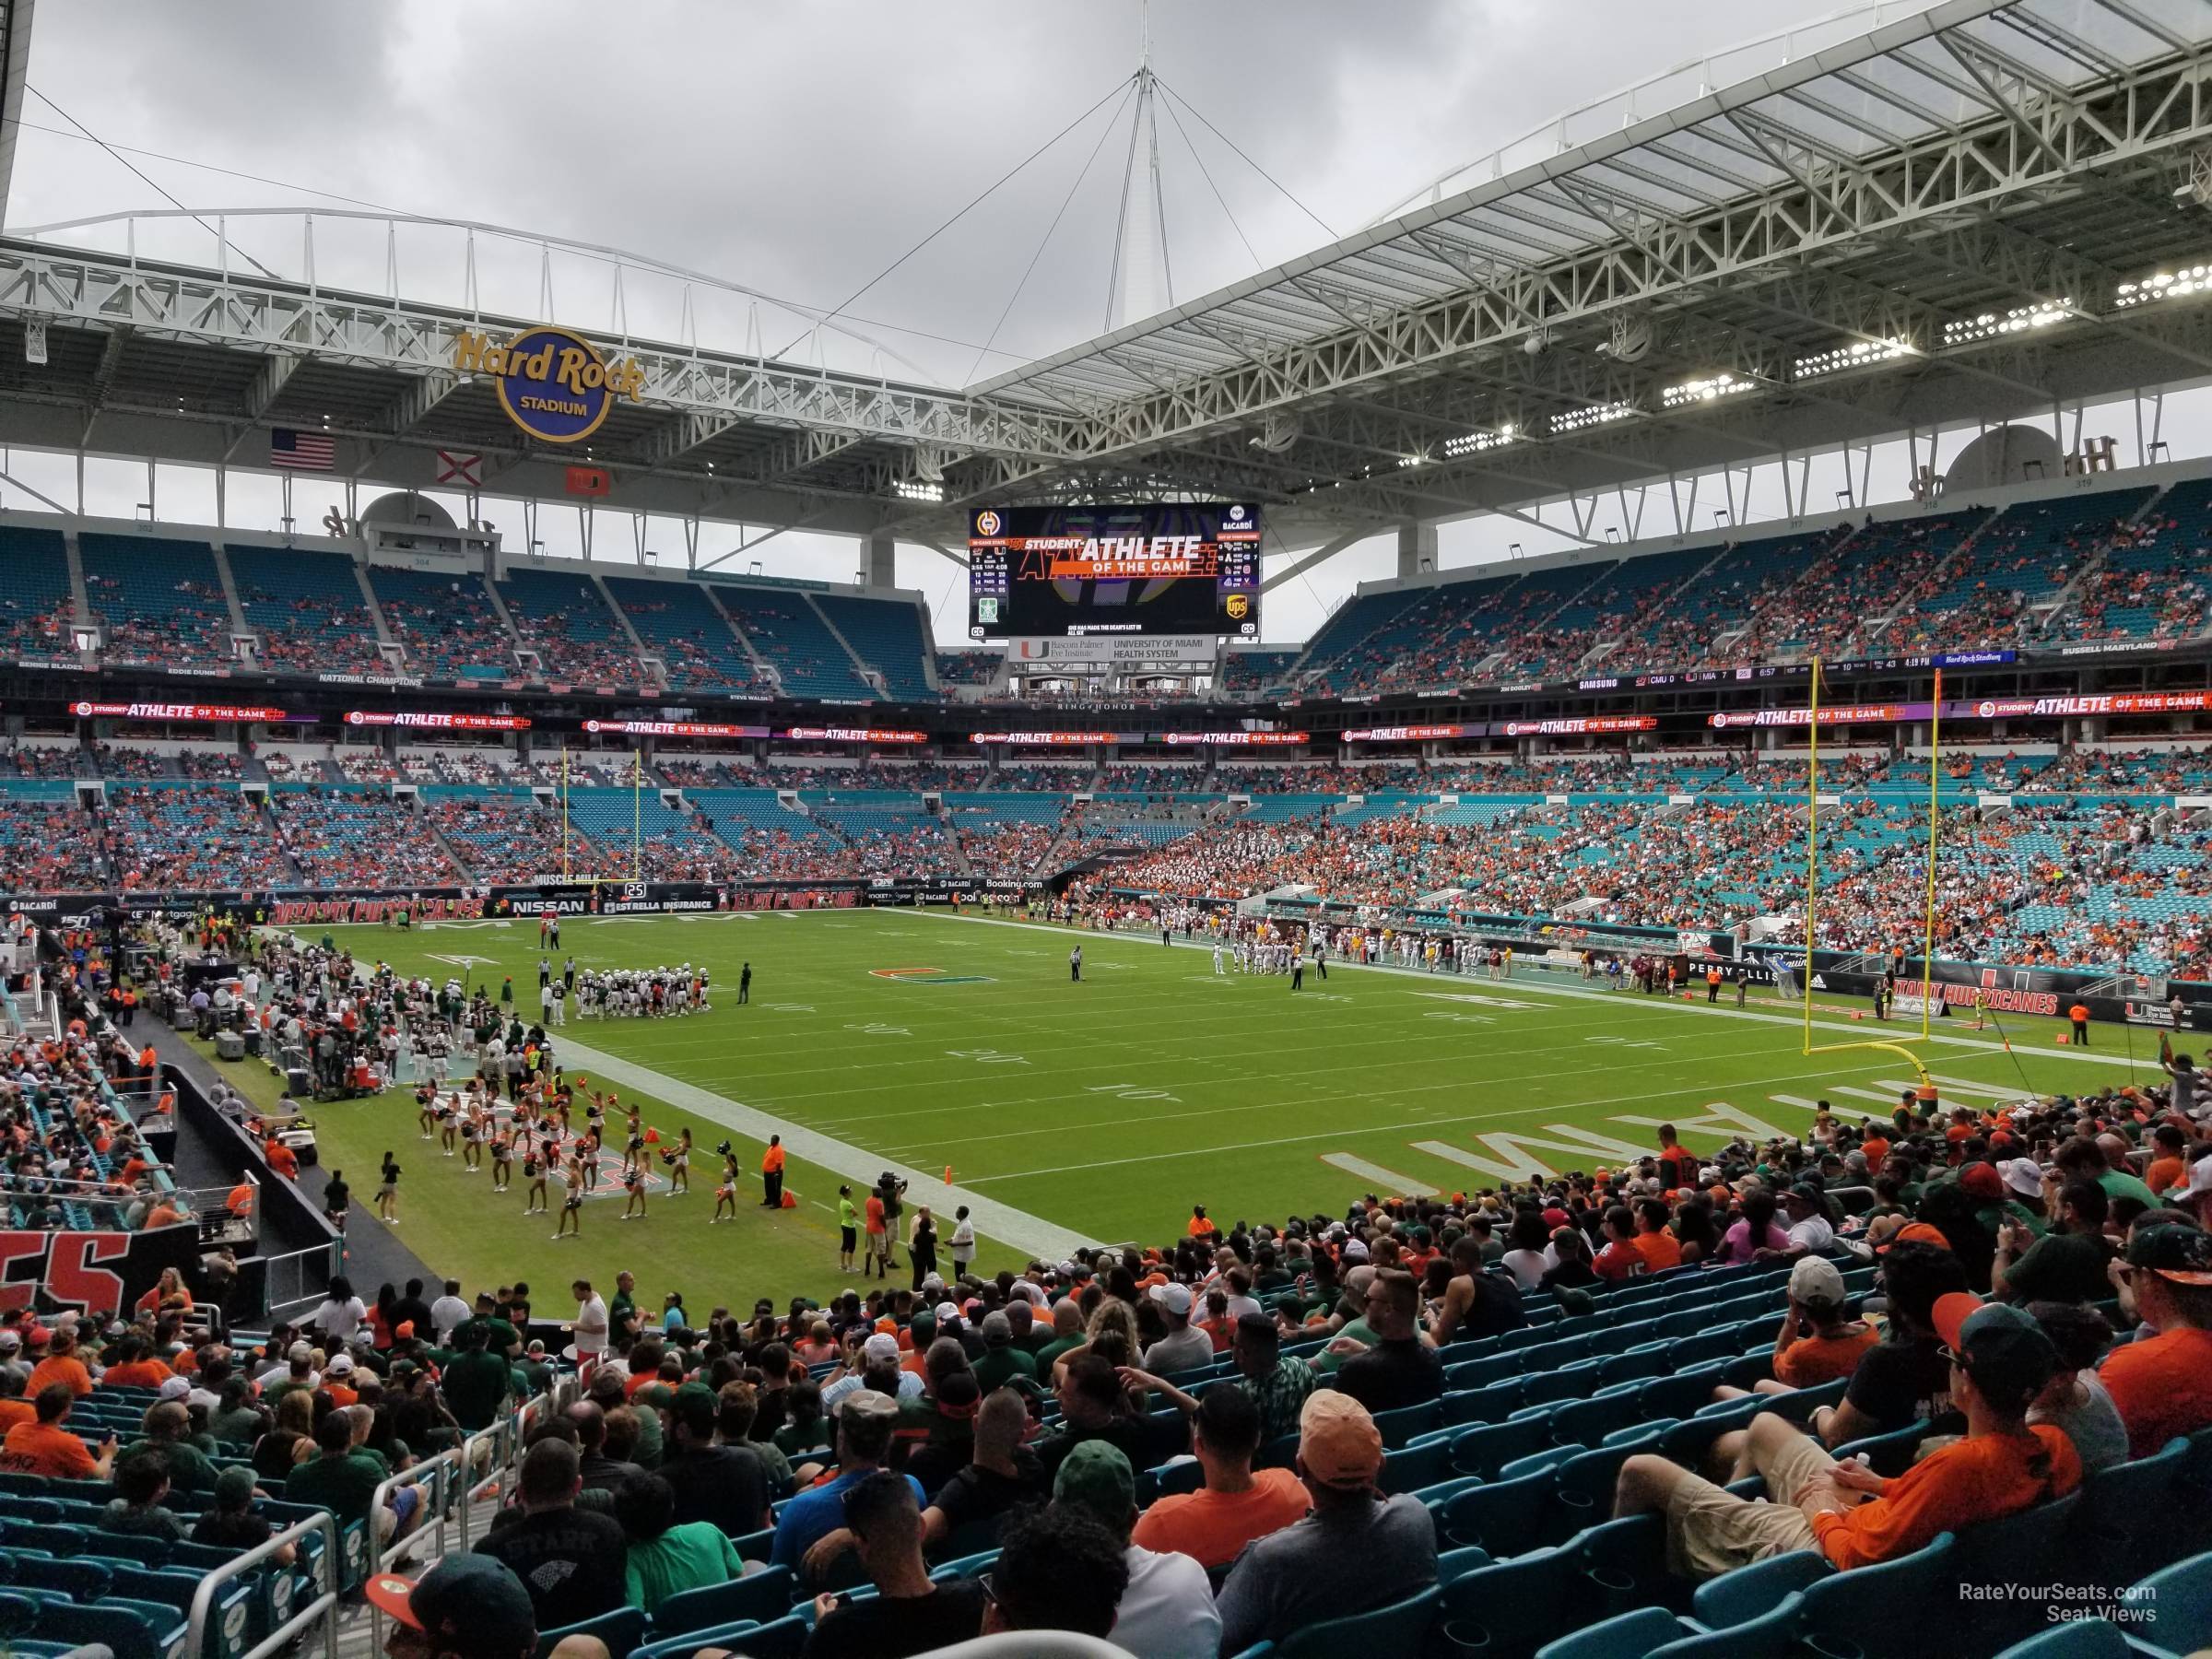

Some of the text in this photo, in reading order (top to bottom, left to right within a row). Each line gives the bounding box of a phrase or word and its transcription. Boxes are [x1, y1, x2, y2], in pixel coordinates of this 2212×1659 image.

[454, 331, 645, 403] Hard Rock
[521, 396, 587, 416] STADIUM
[1223, 520, 1253, 530] BACARDÍ
[1092, 562, 1112, 572] OF
[1119, 561, 1145, 572] THE
[1229, 601, 1246, 616] ups
[1113, 639, 1203, 649] UNIVERSITY OF MIAMI
[2063, 641, 2158, 655] RUSSELL MARYLAND
[1065, 649, 1093, 657] Institute
[1113, 650, 1179, 659] HEALTH SYSTEM
[1975, 653, 2002, 662] Stadium
[1886, 660, 1896, 668] 43
[1702, 672, 1716, 681] MIA
[1759, 668, 1775, 677] 6:57
[319, 674, 422, 687] NATIONAL CHAMPIONS
[1579, 678, 1618, 689] SAMSUNG
[1650, 676, 1667, 684] CMU
[2115, 699, 2132, 708] OF
[2136, 698, 2161, 707] THE
[2166, 696, 2204, 707] GAME
[215, 709, 234, 717] THE
[237, 710, 265, 718] GAME
[534, 874, 600, 886] MUSCLE MILK
[628, 885, 643, 896] 25
[18, 900, 58, 911] BACARDÍ
[512, 900, 712, 913] NISSAN ESTRELLA INSURANCE
